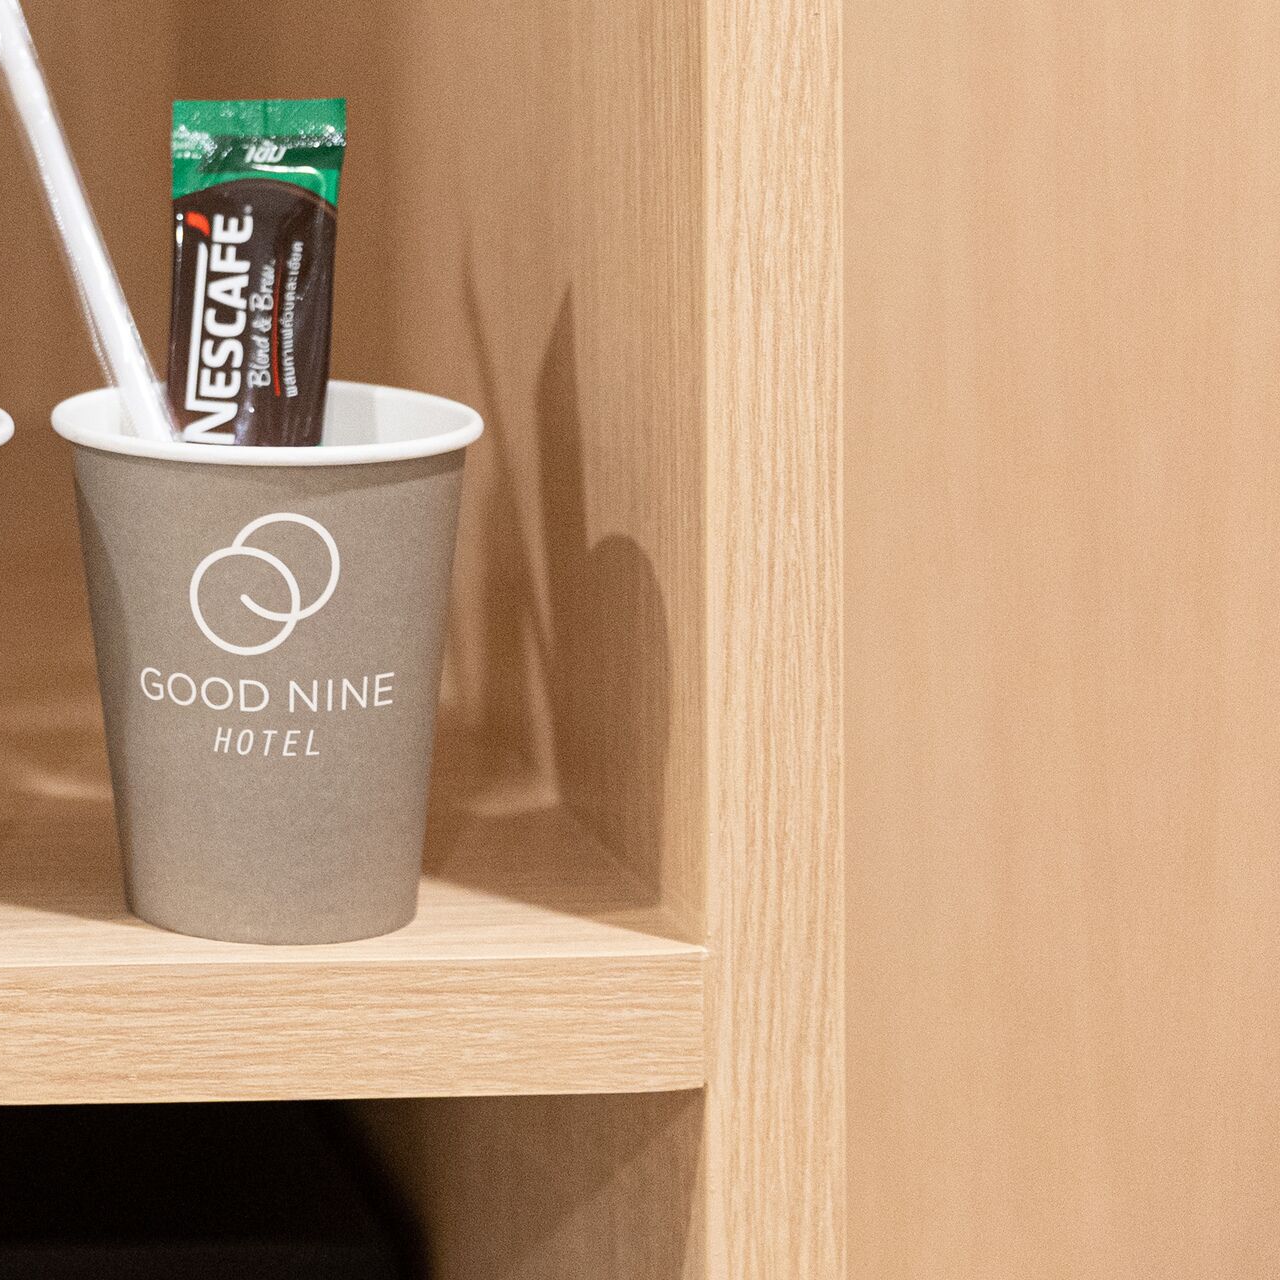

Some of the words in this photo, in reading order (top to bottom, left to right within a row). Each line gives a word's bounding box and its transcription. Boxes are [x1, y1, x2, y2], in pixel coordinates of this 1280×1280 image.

[246, 335, 272, 388] Blend
[140, 667, 270, 713] GOOD
[288, 671, 395, 713] NINE
[213, 727, 320, 756] HOTEL
